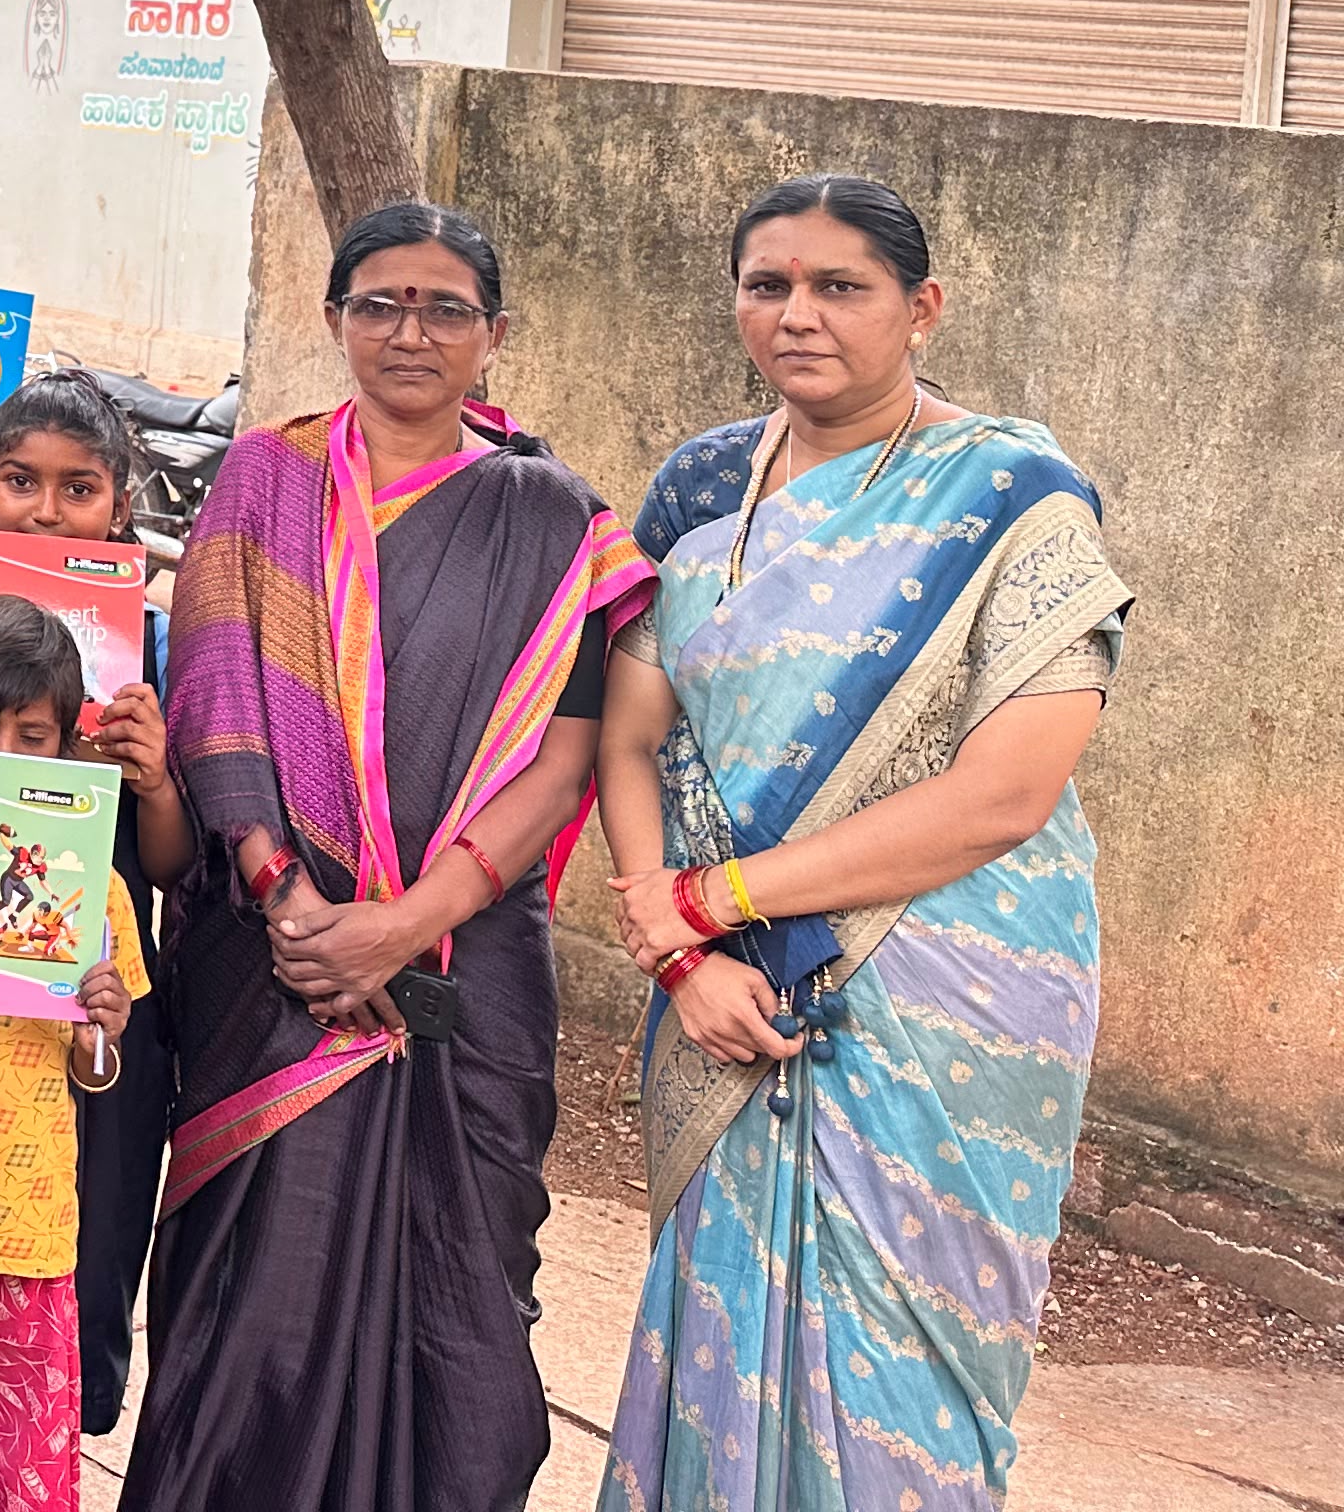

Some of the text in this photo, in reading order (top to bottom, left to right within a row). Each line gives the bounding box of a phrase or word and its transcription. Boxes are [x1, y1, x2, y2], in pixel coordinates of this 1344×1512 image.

[173, 92, 249, 156] ಸ್ವಾಗತ
[56, 604, 100, 624] sert
[69, 624, 108, 644] rip
[21, 789, 73, 805] Brilliance
